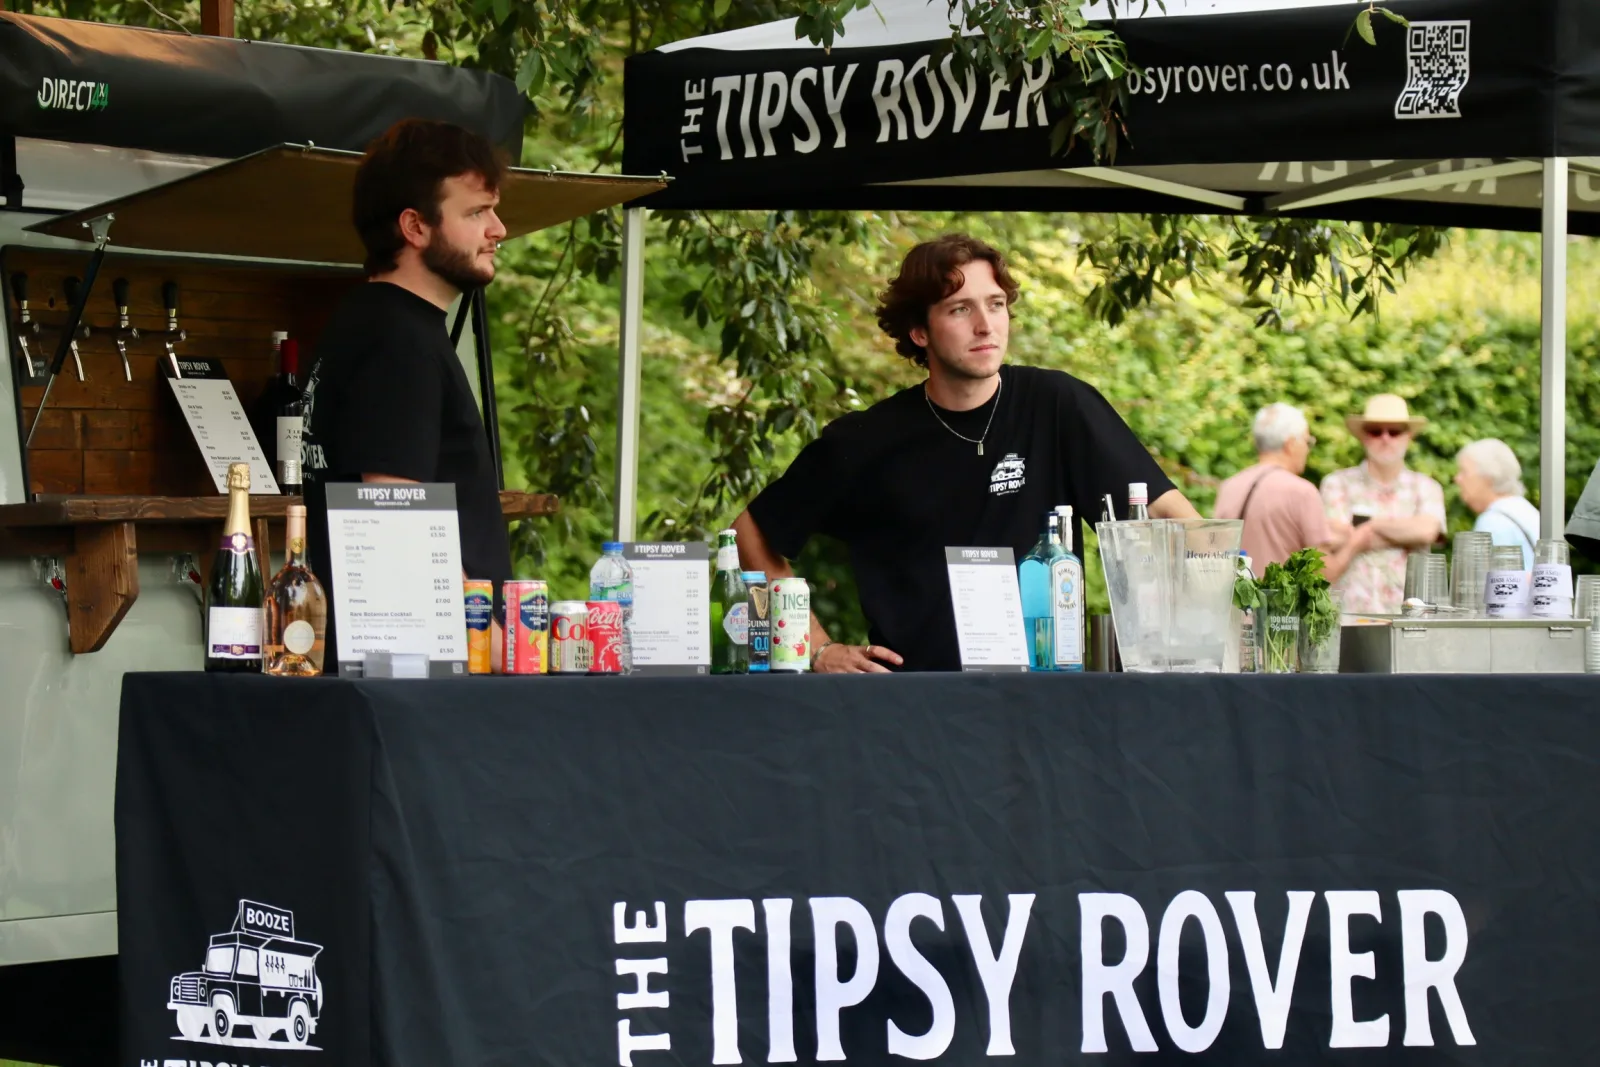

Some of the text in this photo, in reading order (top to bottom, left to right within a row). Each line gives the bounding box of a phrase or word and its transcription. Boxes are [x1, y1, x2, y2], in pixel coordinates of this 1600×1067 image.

[681, 78, 705, 163] THE
[712, 63, 859, 160] TIPSY
[363, 488, 391, 500] TIPSY
[393, 488, 426, 500] ROVER
[640, 545, 660, 553] TIPSY
[661, 545, 686, 553] ROVER
[1186, 550, 1210, 559] Henri
[246, 908, 290, 932] BOOZE
[614, 889, 1477, 1067] THE TIPSY ROVER
